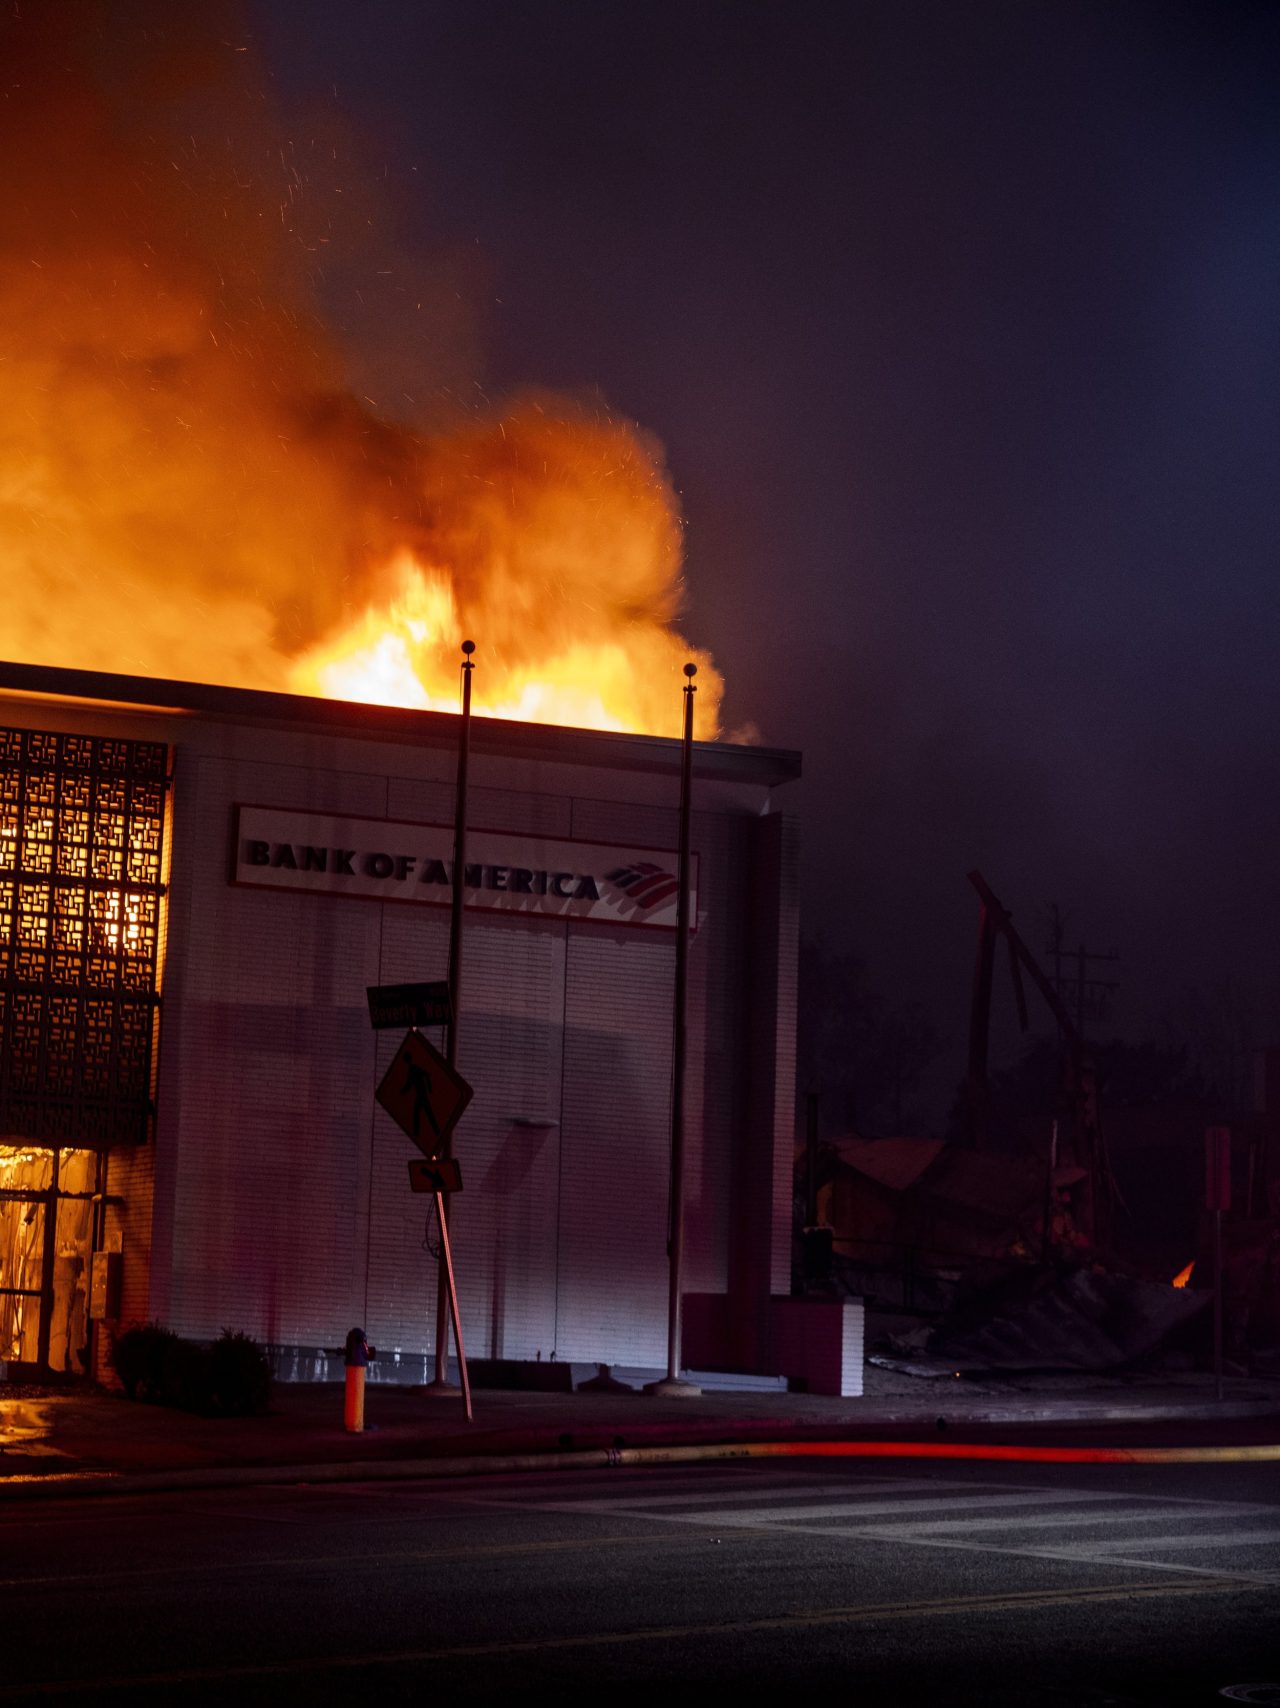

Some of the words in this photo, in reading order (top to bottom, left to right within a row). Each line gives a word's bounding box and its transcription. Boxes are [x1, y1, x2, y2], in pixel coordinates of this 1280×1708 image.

[245, 839, 357, 875] BANK
[364, 853, 417, 880] OF
[420, 860, 600, 900] AMERICA
